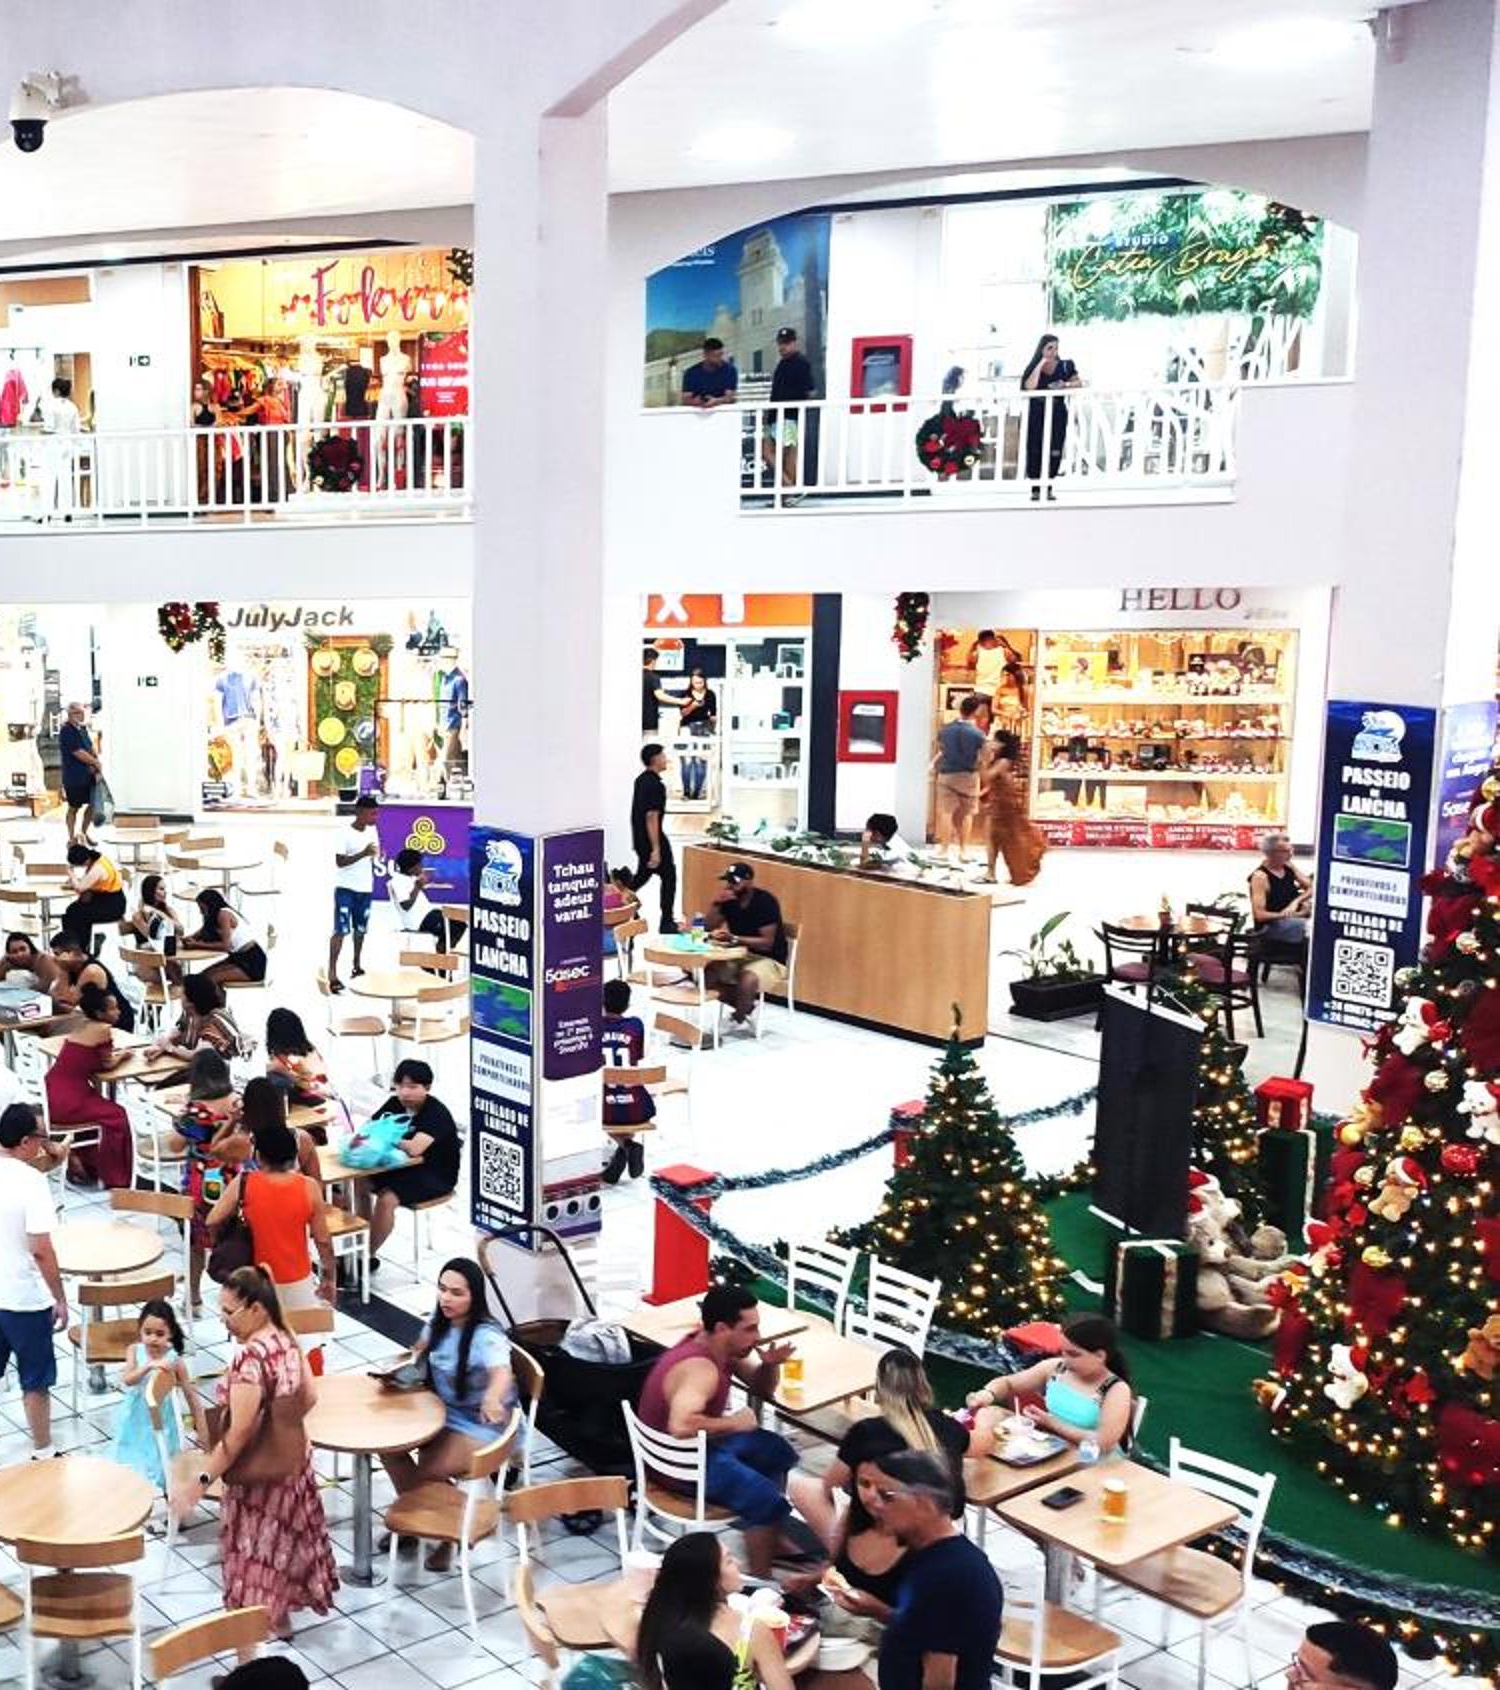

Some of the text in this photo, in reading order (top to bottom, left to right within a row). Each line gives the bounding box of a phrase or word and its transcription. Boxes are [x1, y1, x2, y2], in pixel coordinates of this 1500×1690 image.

[1119, 587, 1242, 612] HELLO
[227, 605, 354, 633] JulyJack
[1342, 765, 1411, 790] PASSEIO
[1341, 794, 1407, 819] LANCHA
[553, 862, 595, 880] Tchau
[548, 876, 599, 895] tanque,
[553, 891, 594, 909] adeus
[473, 906, 530, 941] PASSEIO
[1343, 924, 1388, 943] LANCHA
[1388, 918, 1404, 933] DE
[475, 943, 529, 978] LANCHA
[601, 1047, 631, 1068] 11
